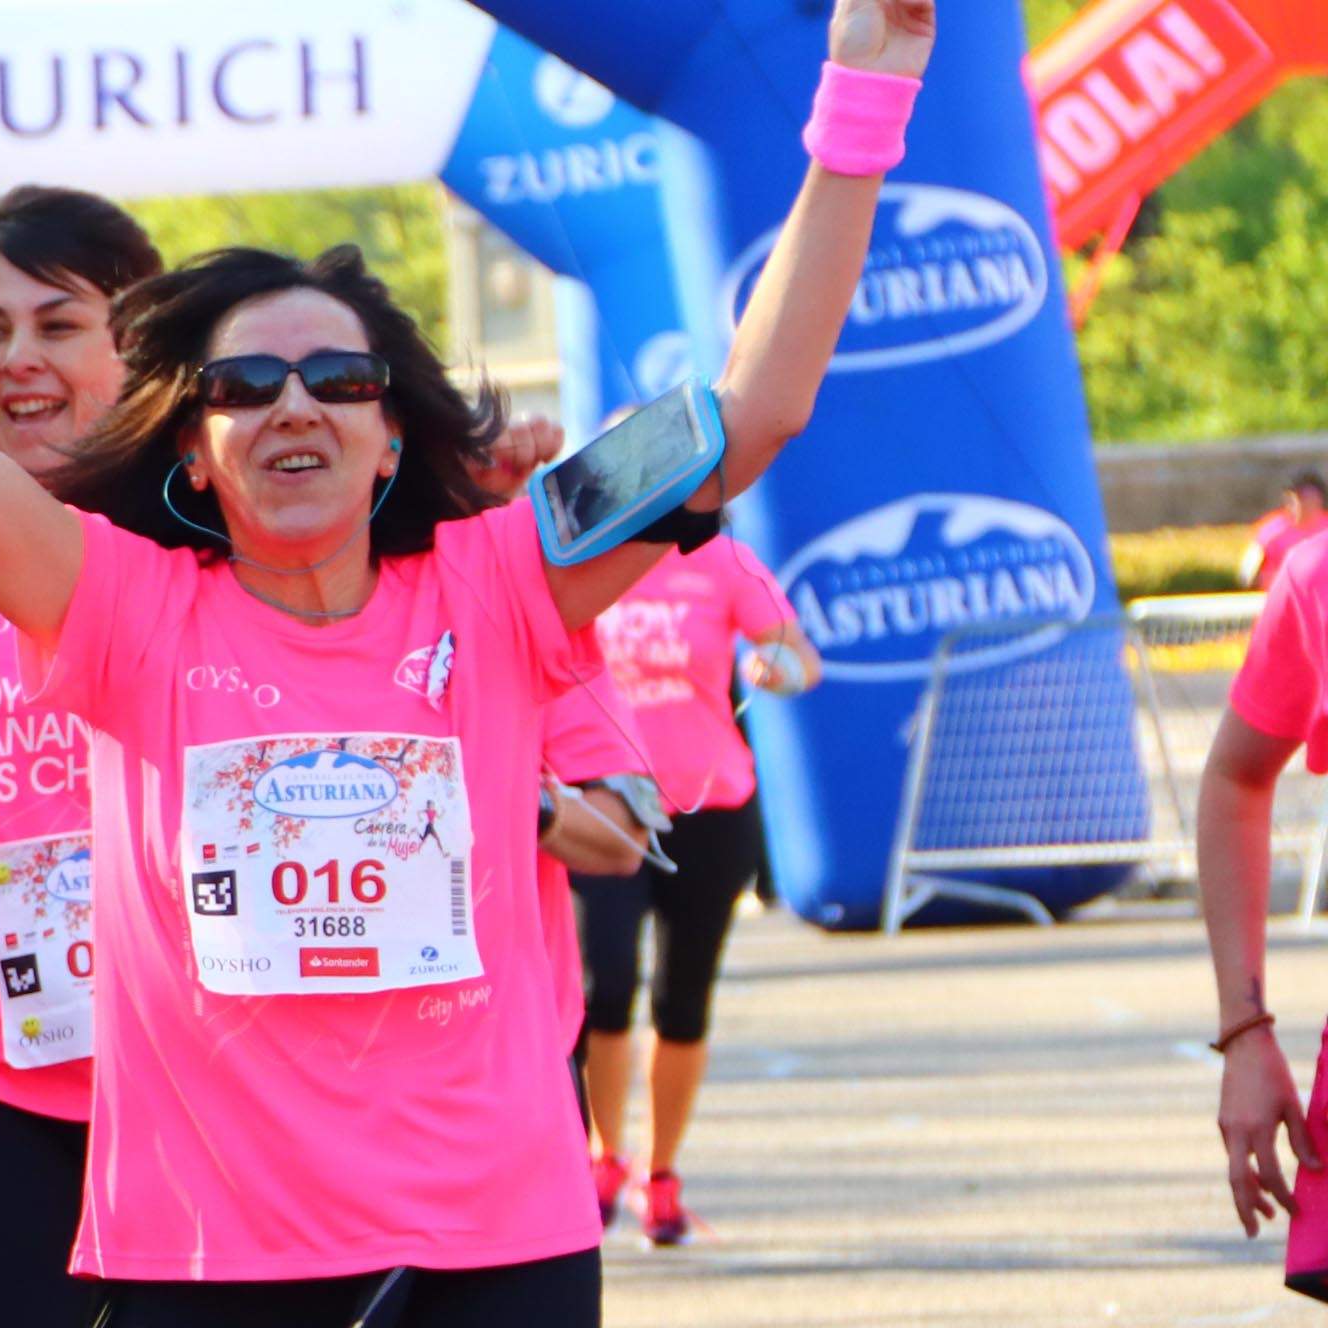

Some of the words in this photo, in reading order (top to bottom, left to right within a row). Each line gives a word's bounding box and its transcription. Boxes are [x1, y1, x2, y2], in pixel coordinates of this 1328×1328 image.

[852, 252, 1034, 326] URIANA
[796, 560, 1082, 650] ASTURIANA
[186, 665, 280, 708] OYSO
[266, 778, 387, 803] ASTURIANA
[354, 818, 407, 834] Carrera
[272, 859, 387, 905] 016
[294, 916, 366, 937] 31688
[202, 956, 271, 972] OYSHO
[323, 957, 369, 968] Santander
[409, 964, 458, 975] ZURICH
